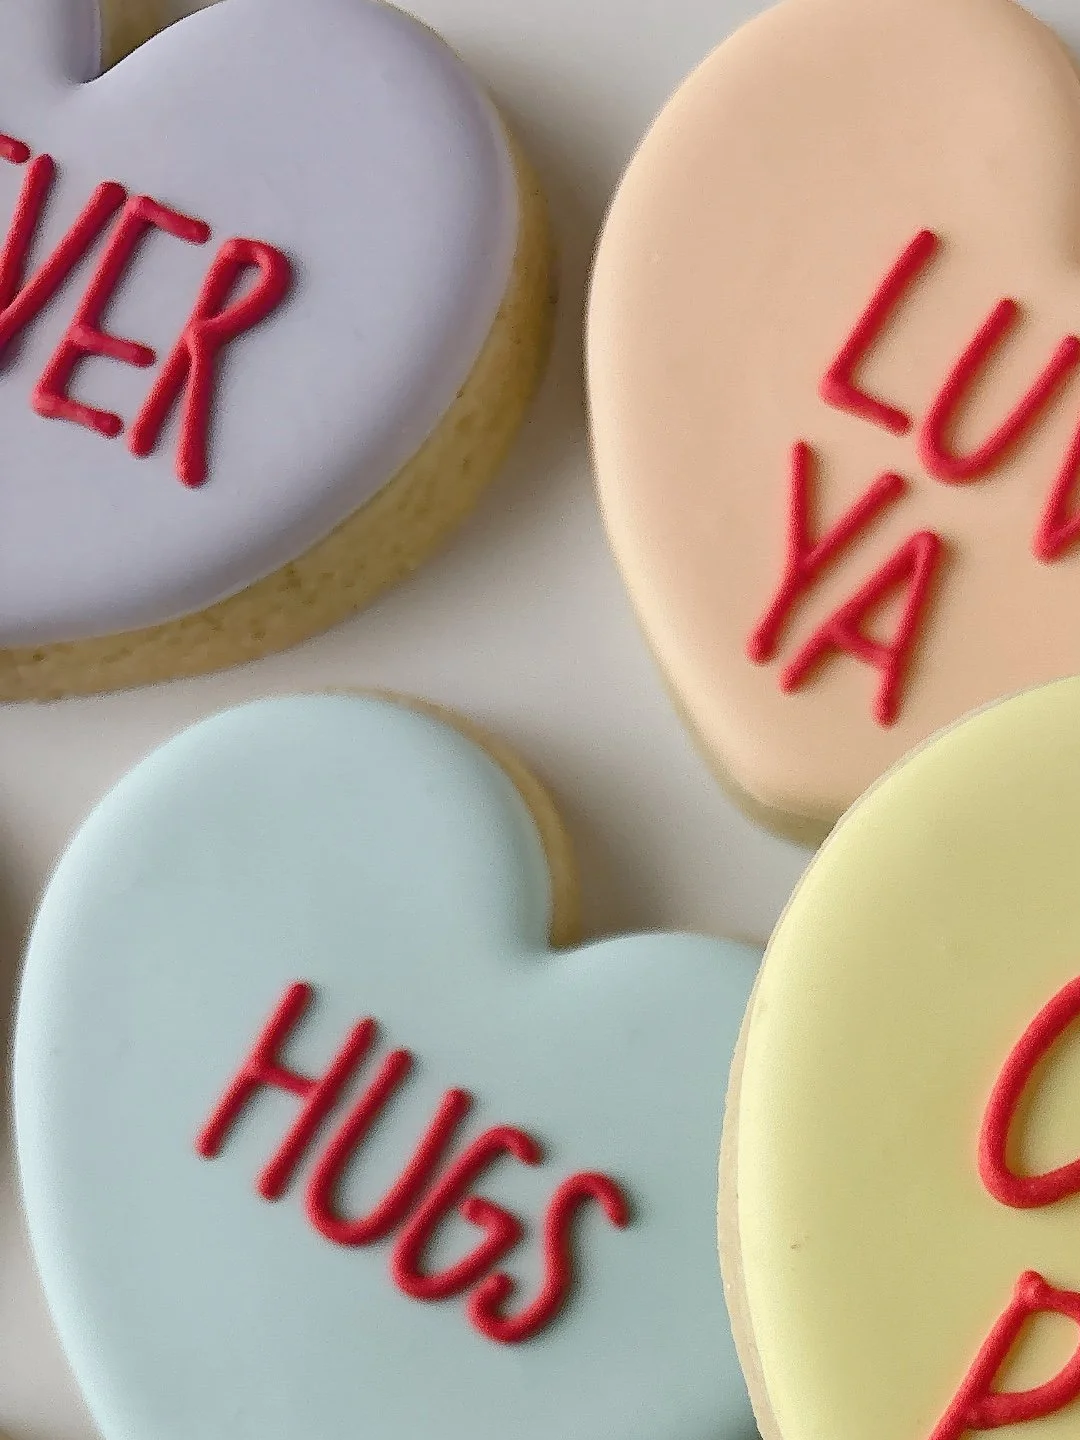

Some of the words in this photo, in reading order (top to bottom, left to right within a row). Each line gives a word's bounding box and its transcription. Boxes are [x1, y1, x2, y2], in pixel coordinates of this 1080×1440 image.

[0, 133, 295, 489] VER
[744, 438, 950, 731] YA
[198, 983, 631, 1345] HUGS
